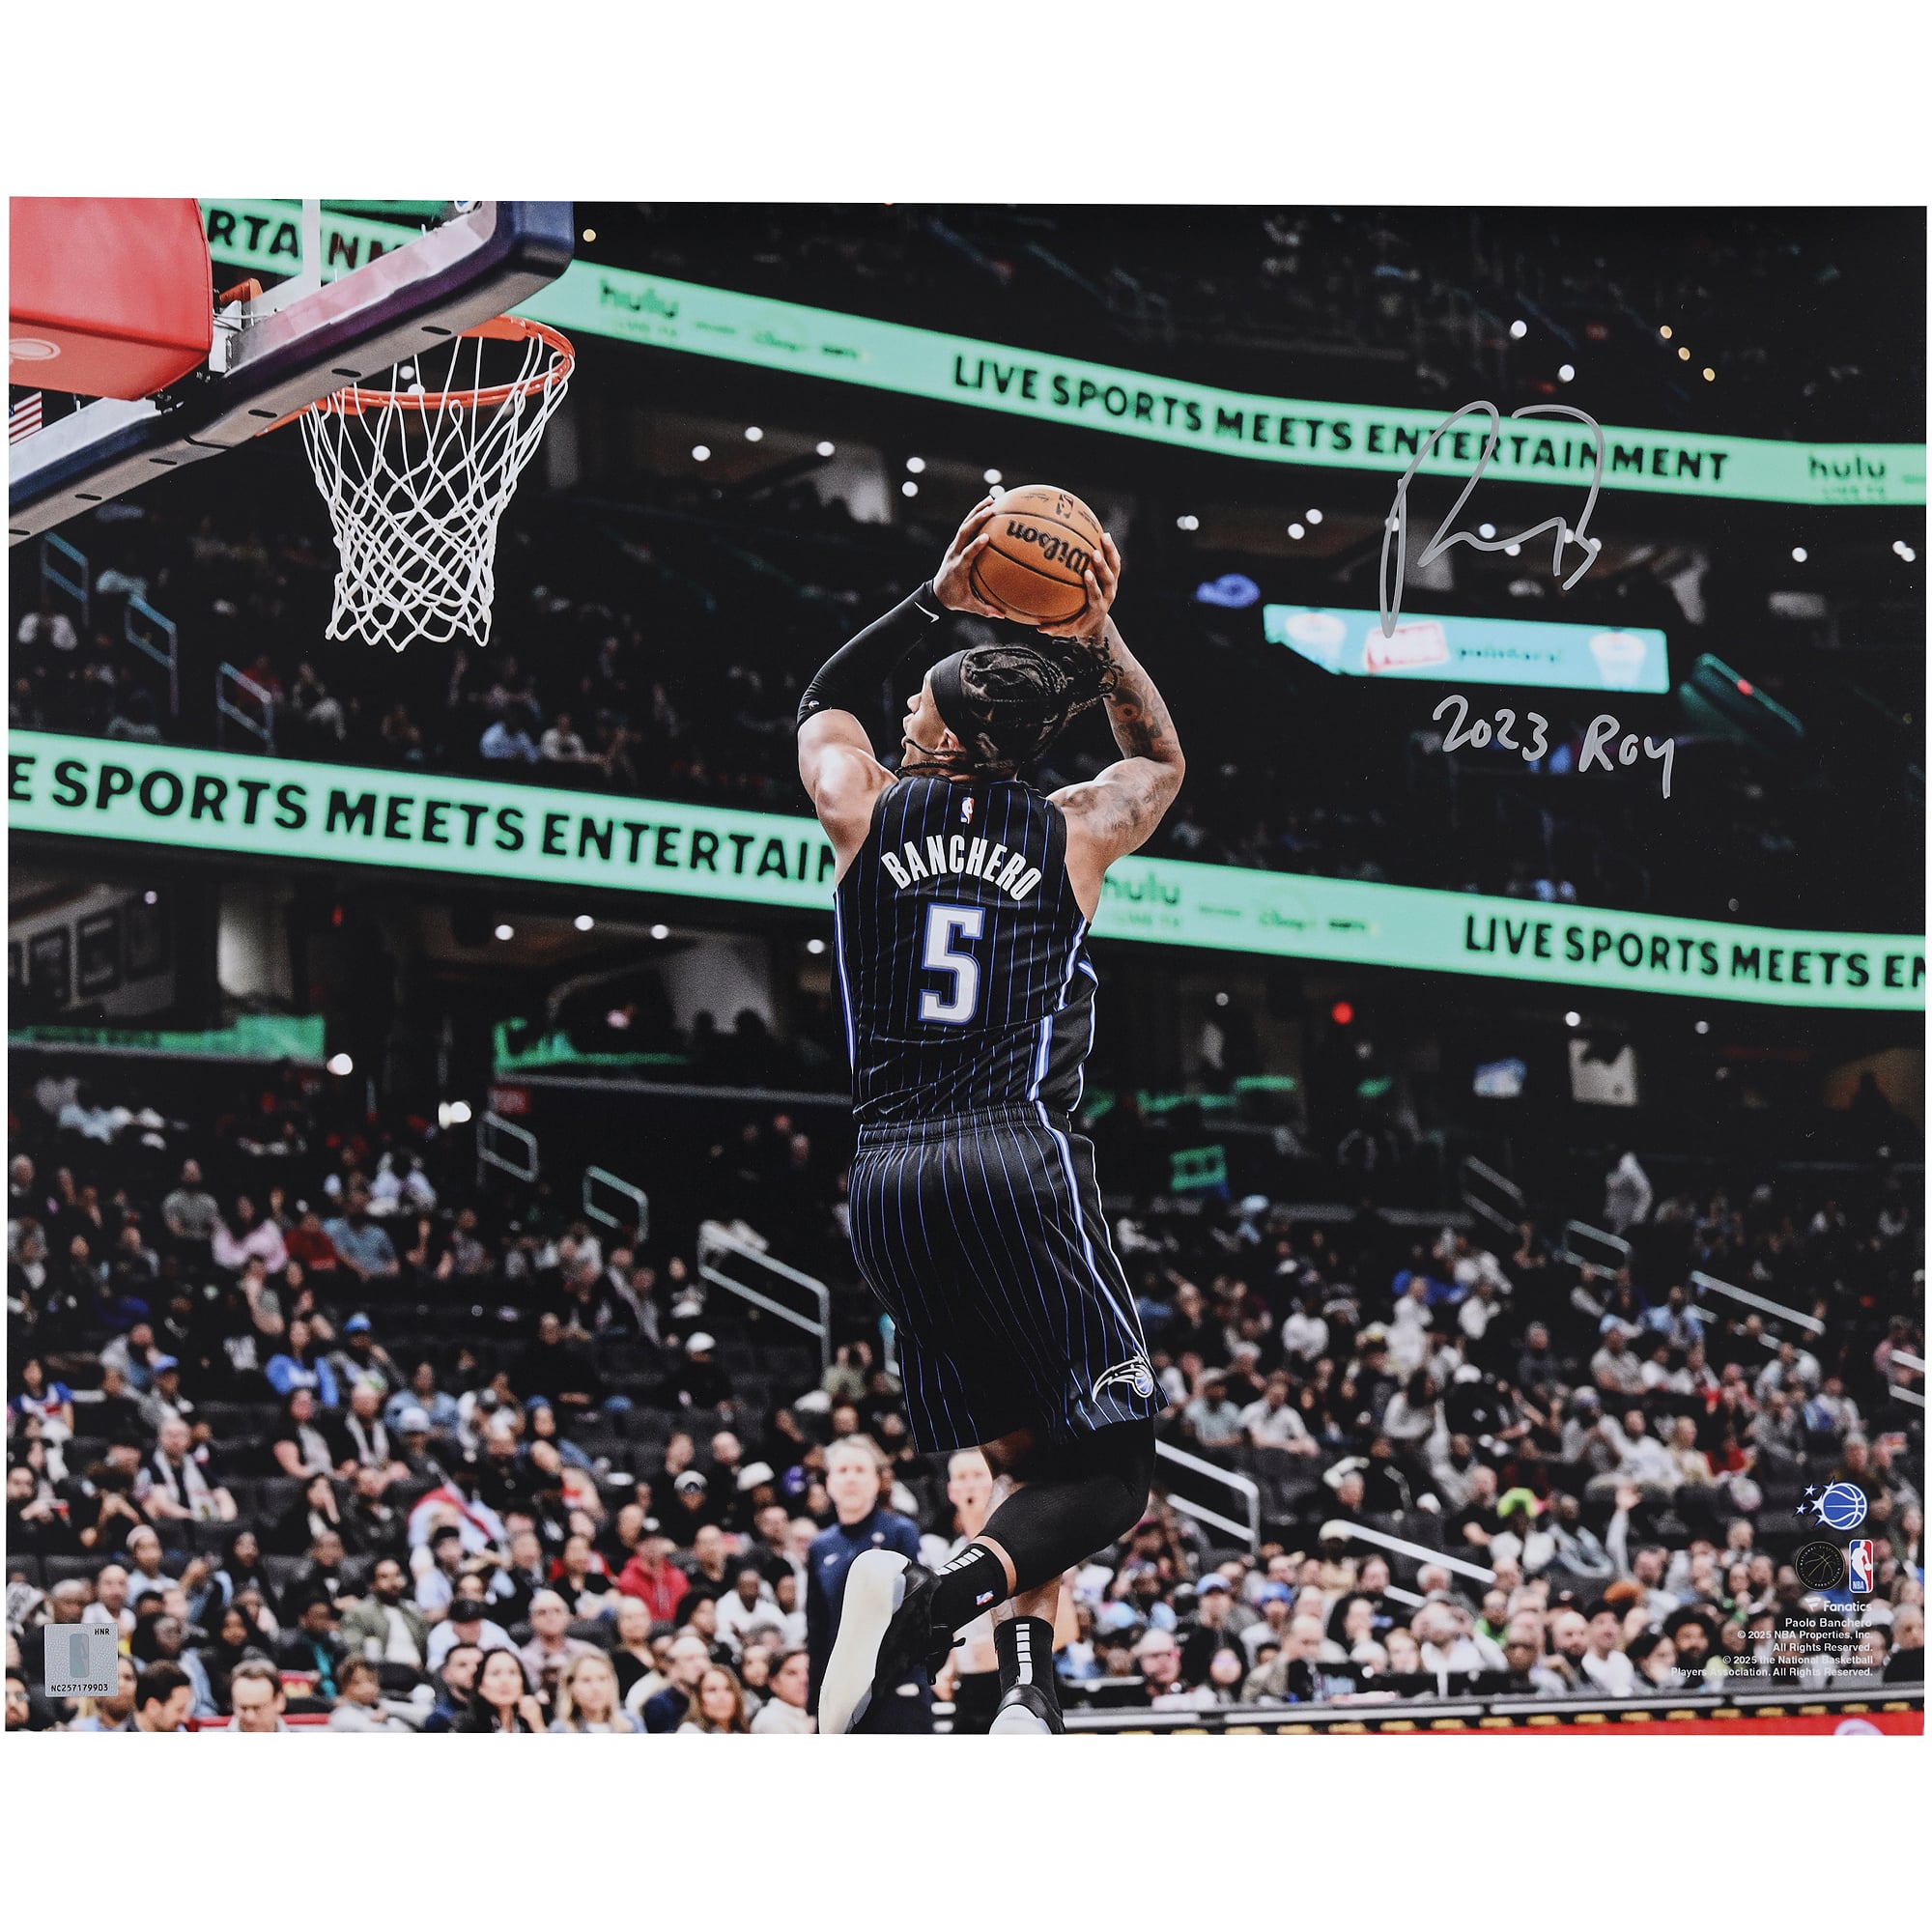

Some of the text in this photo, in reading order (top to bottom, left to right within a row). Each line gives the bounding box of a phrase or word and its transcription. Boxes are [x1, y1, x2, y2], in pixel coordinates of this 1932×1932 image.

[954, 355, 1729, 482] LIVE SPORTS MEETS ENTERTAINMENT
[1807, 455, 1886, 478] hulu
[1006, 519, 1091, 577] Wilson
[1433, 694, 1548, 762] 2023
[52, 759, 307, 830] SPORTS
[326, 789, 525, 850] MEETS
[880, 834, 1042, 901] BANCHERO
[918, 901, 986, 1026] 5
[1465, 915, 1553, 959] LIVE
[1565, 926, 1719, 976] SPORTS
[1731, 944, 1870, 986] MEETS
[50, 1683, 108, 1692] NC257179903
